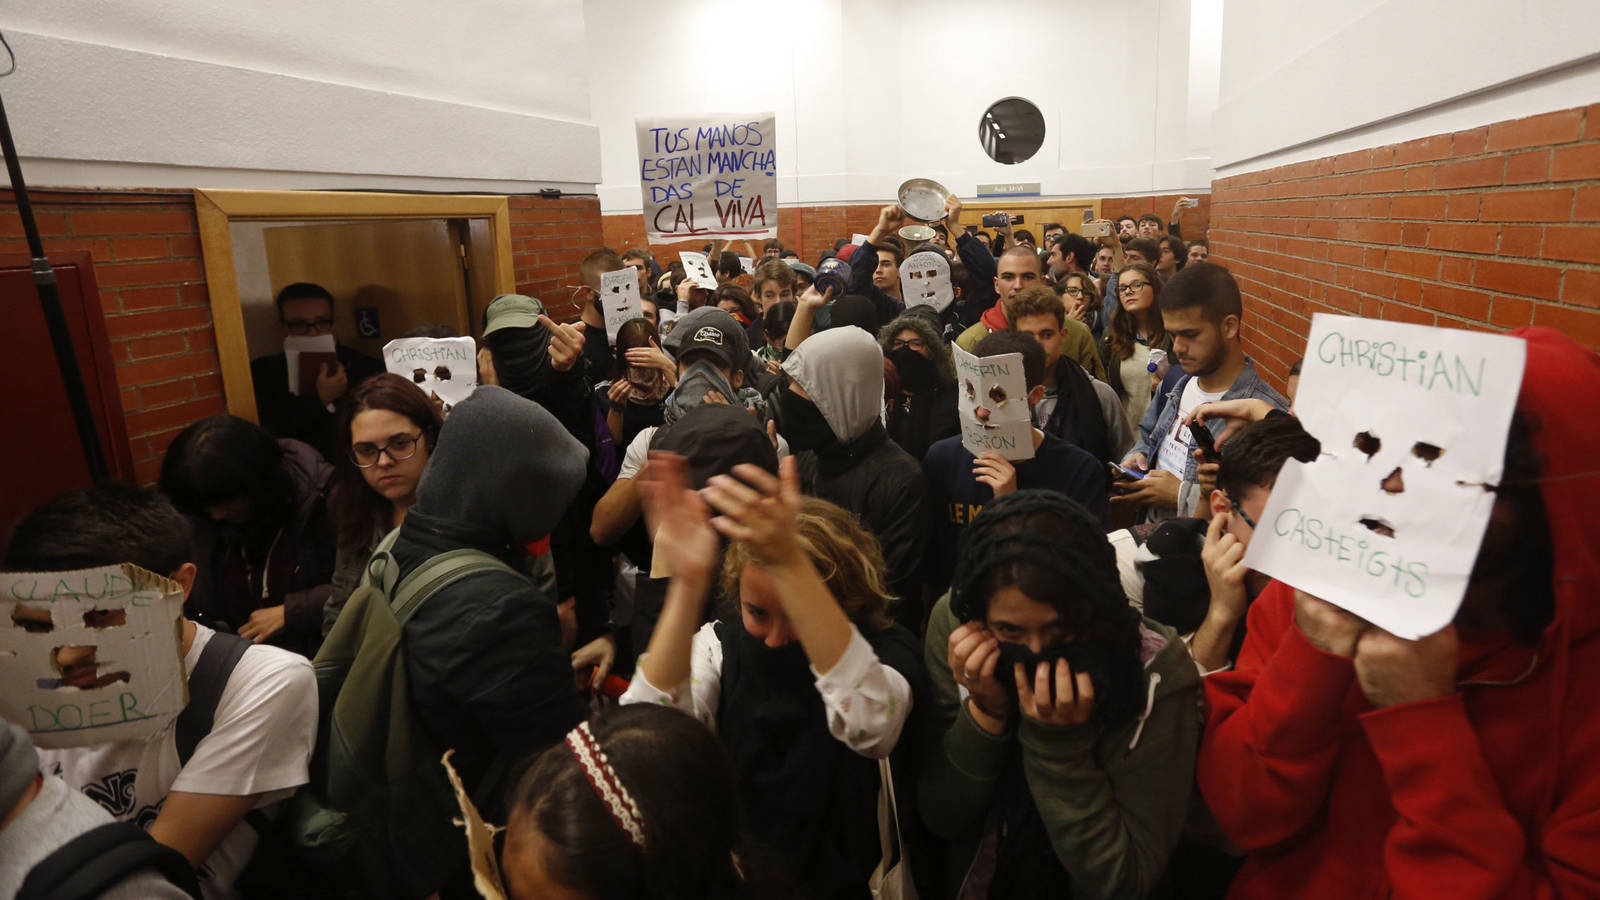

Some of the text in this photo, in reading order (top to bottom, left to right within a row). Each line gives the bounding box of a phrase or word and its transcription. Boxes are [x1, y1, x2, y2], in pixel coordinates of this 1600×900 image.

[649, 122, 762, 153] TUS MANOS
[642, 149, 776, 181] ESTAN MANCHA
[650, 179, 745, 203] DAS DE
[654, 195, 766, 233] CAL VIVA
[11, 573, 160, 607] CLAUDE
[28, 692, 150, 732] DOER
